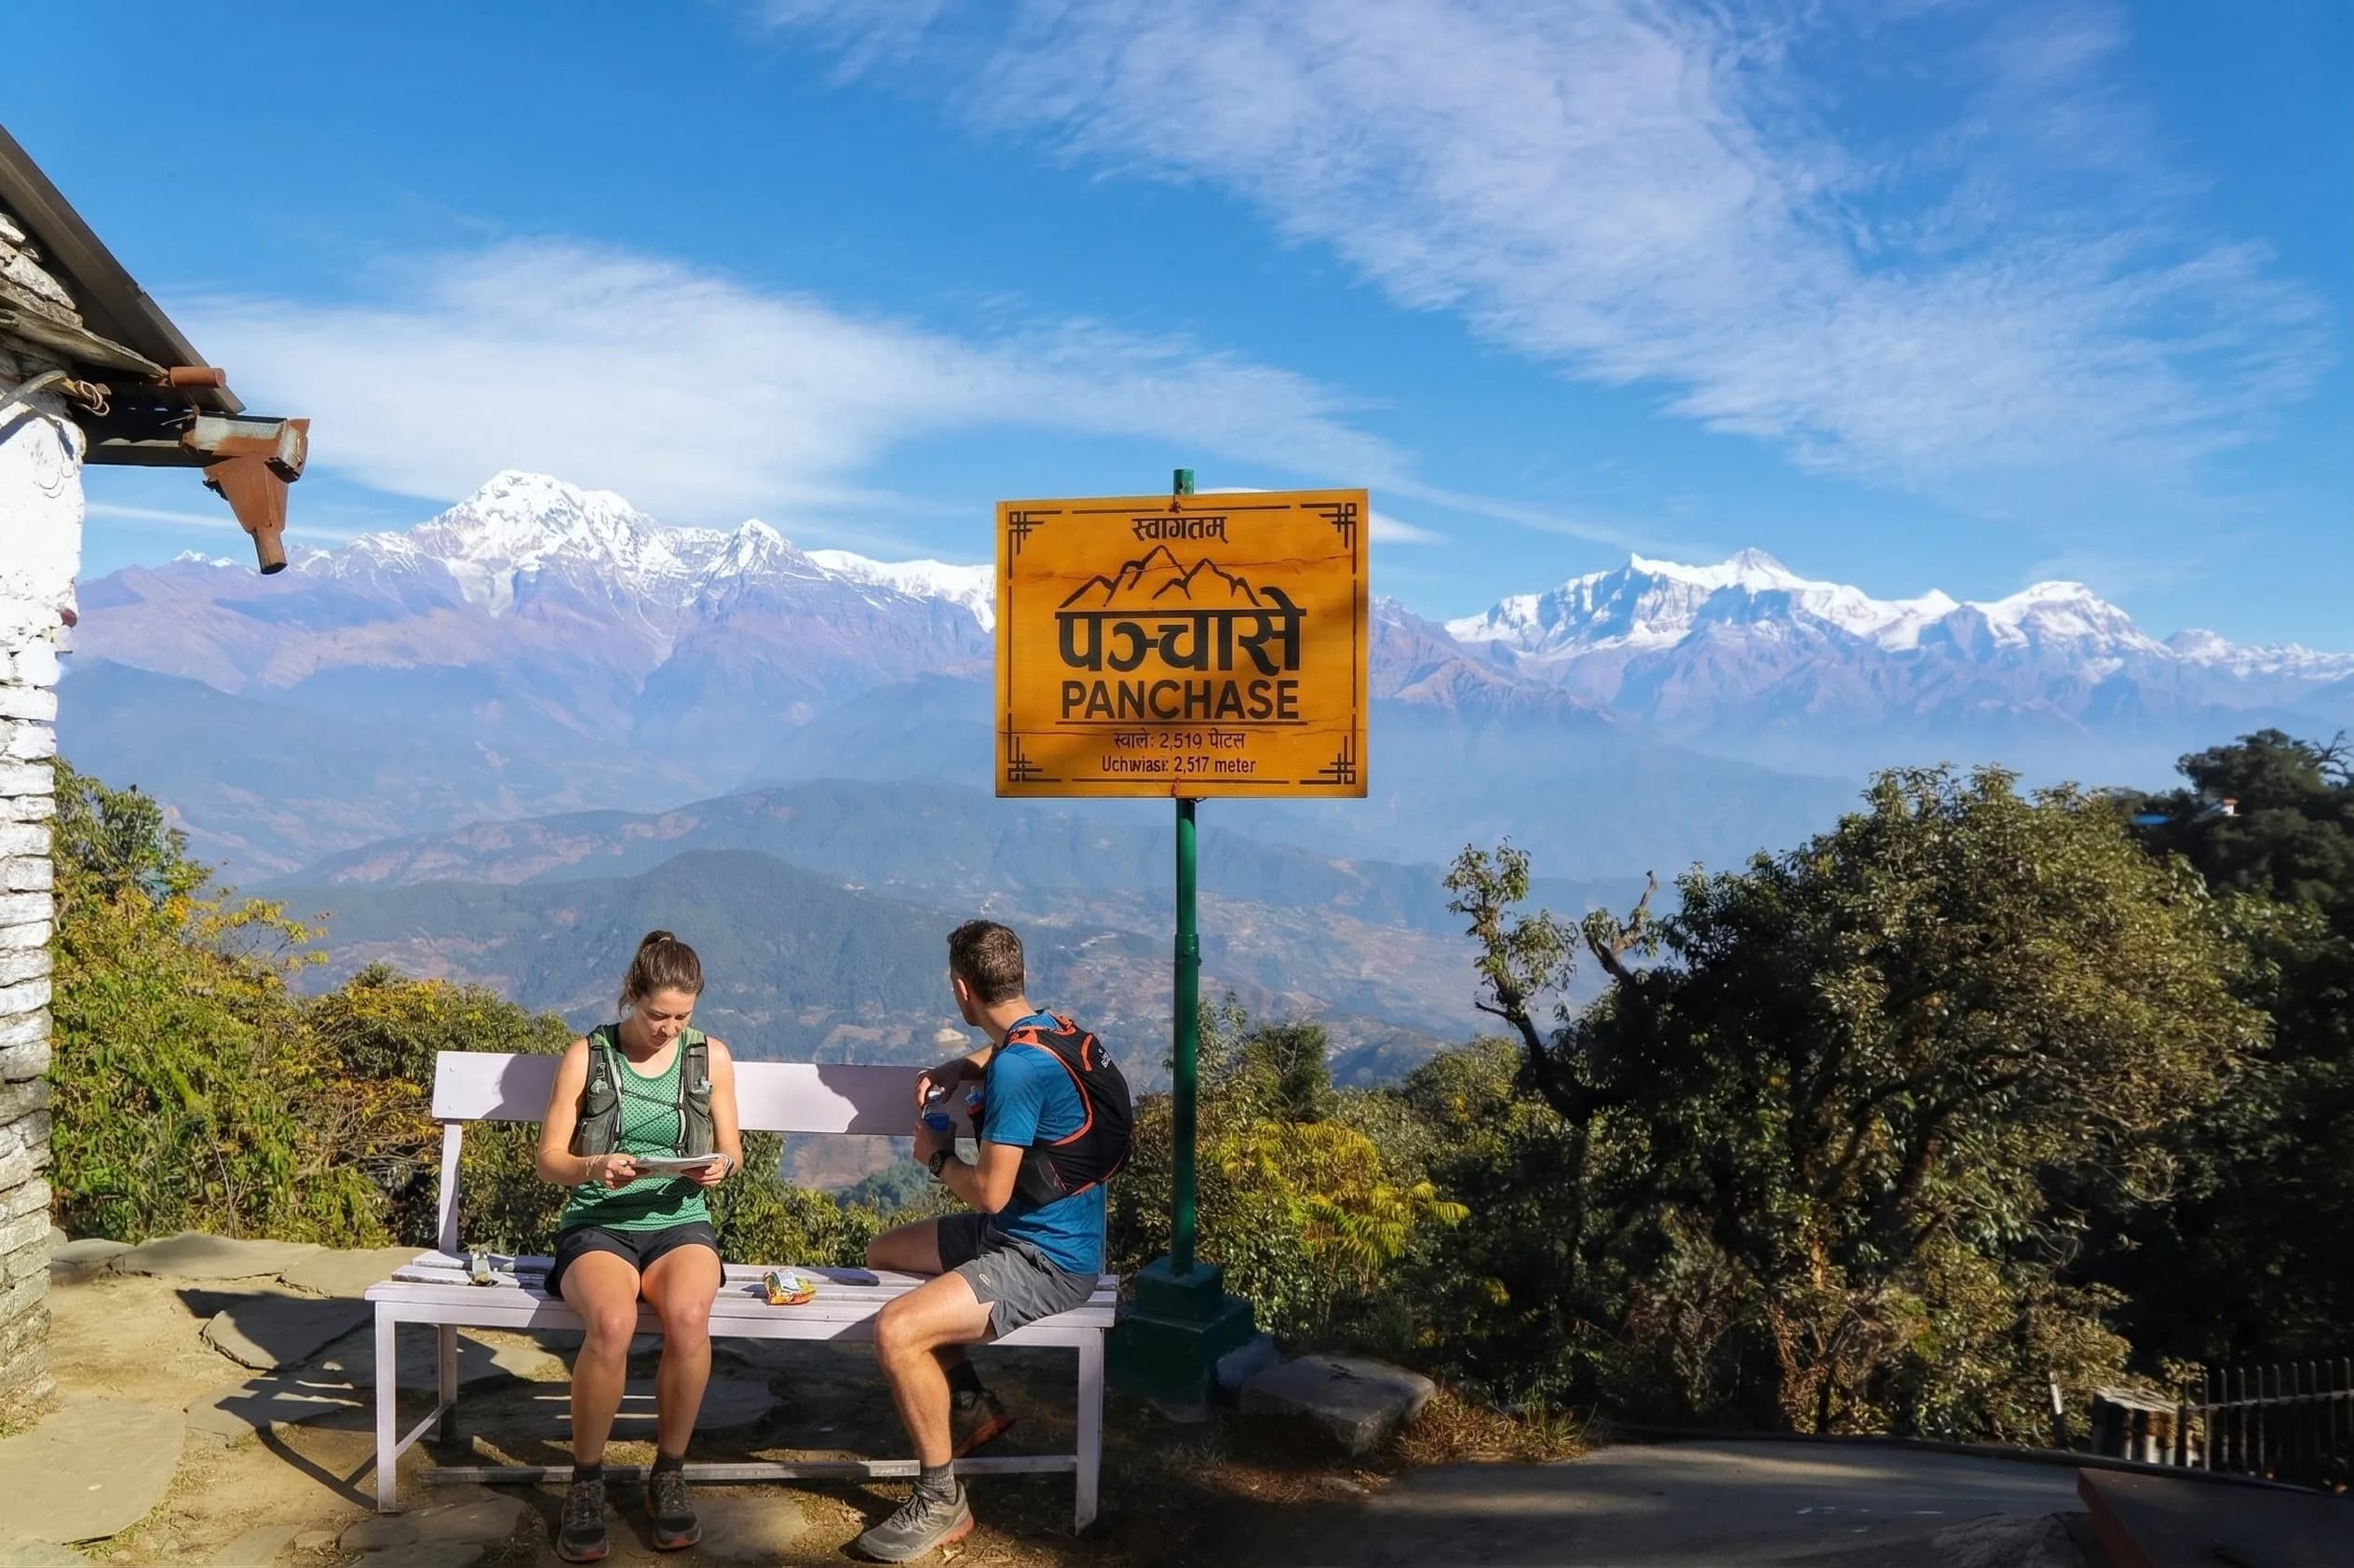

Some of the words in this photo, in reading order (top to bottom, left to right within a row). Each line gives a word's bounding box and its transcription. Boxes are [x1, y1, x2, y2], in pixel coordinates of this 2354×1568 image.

[1131, 516, 1229, 544] स्वागतम्
[1062, 680, 1299, 720] PANCHASE
[1159, 733, 1202, 751] 2,519
[1173, 755, 1210, 775] 2,517
[1214, 757, 1256, 774] meter
